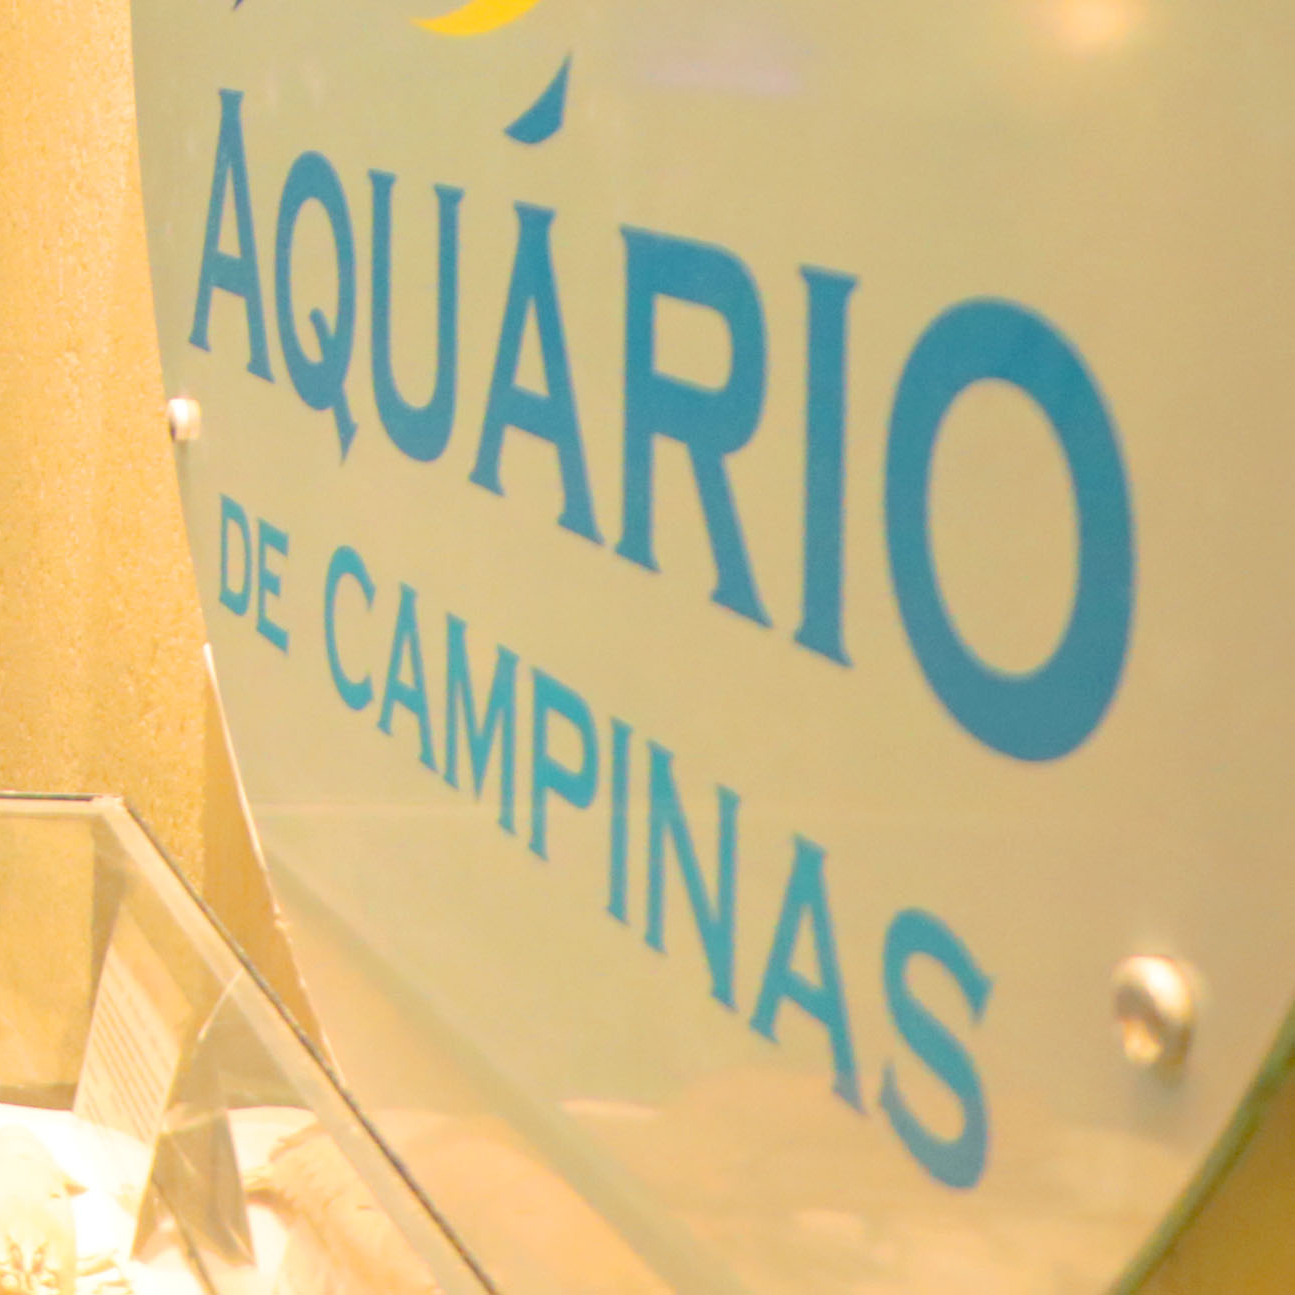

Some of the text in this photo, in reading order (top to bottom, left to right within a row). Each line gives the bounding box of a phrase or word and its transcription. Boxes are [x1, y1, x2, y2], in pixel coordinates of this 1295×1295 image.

[188, 51, 1138, 764] AQUÁRIO
[220, 492, 290, 655] DE
[324, 545, 995, 1192] CAMPINAS
